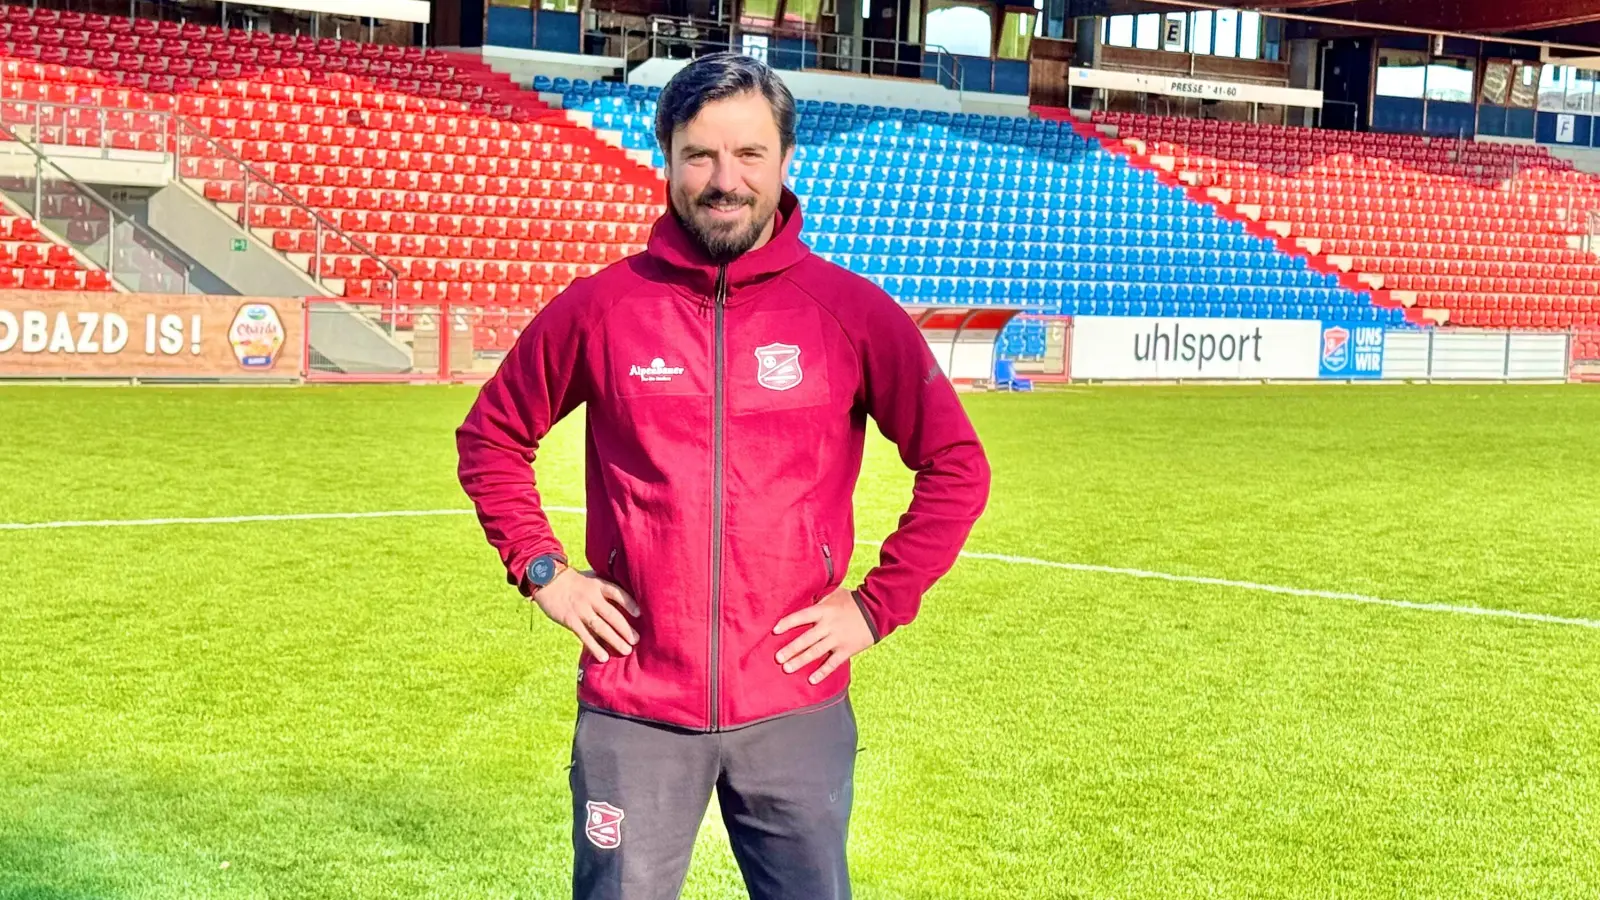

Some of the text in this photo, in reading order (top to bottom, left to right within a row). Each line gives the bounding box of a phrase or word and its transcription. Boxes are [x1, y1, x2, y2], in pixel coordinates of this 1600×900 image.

[1167, 24, 1179, 41] E
[1170, 82, 1204, 94] PRESSE
[1560, 120, 1570, 136] F
[145, 312, 201, 355] IS!
[1355, 326, 1383, 346] UNS
[1134, 322, 1263, 371] uhlsport
[1354, 353, 1381, 371] WIR
